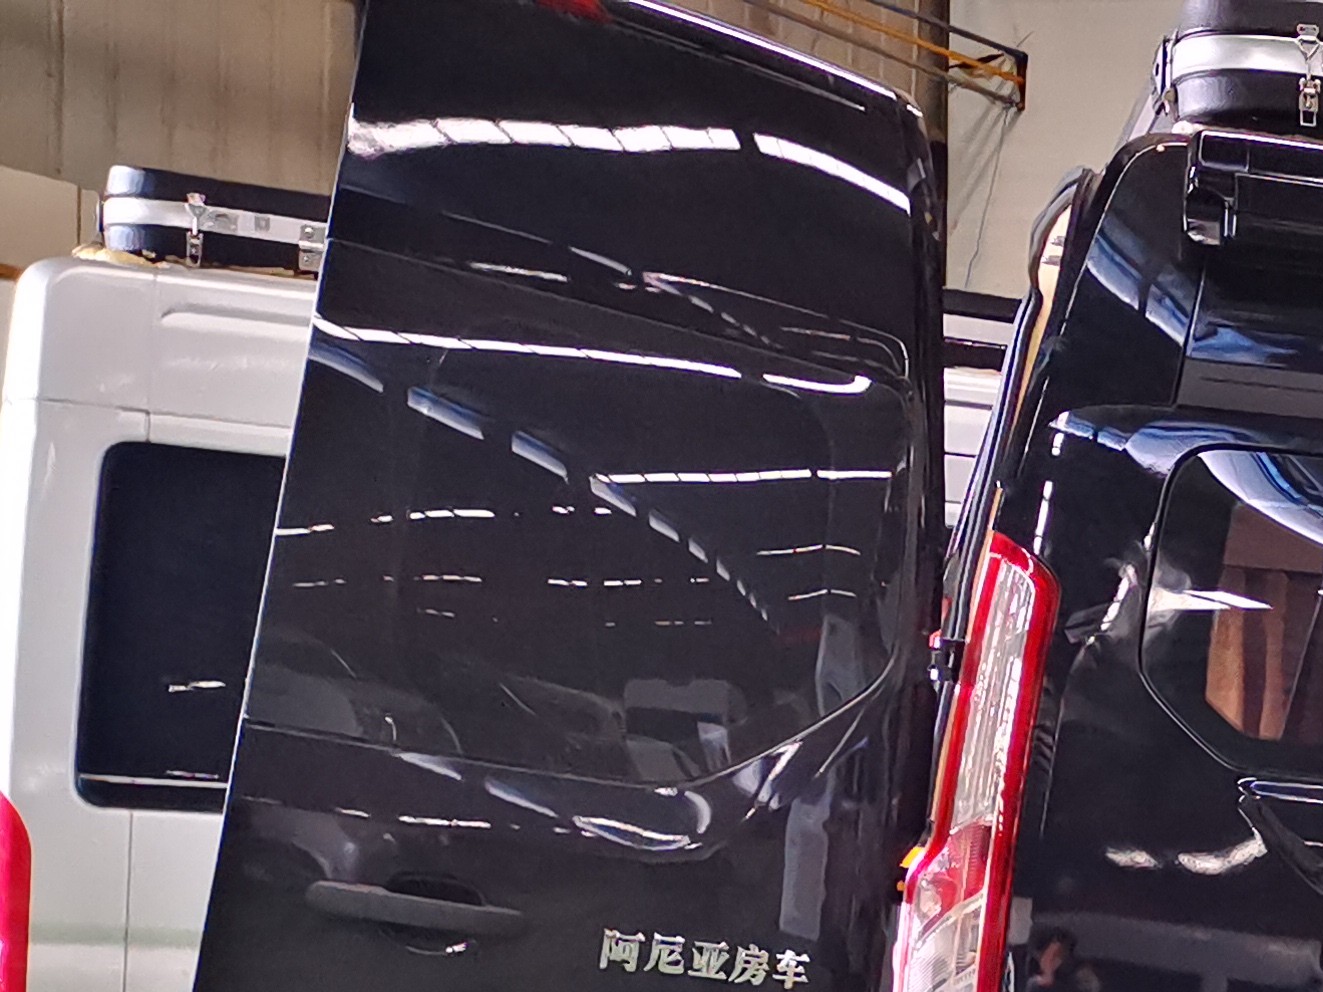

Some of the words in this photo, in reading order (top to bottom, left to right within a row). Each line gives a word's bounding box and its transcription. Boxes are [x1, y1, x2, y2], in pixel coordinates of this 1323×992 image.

[599, 928, 811, 990] 阿尼亚房车
